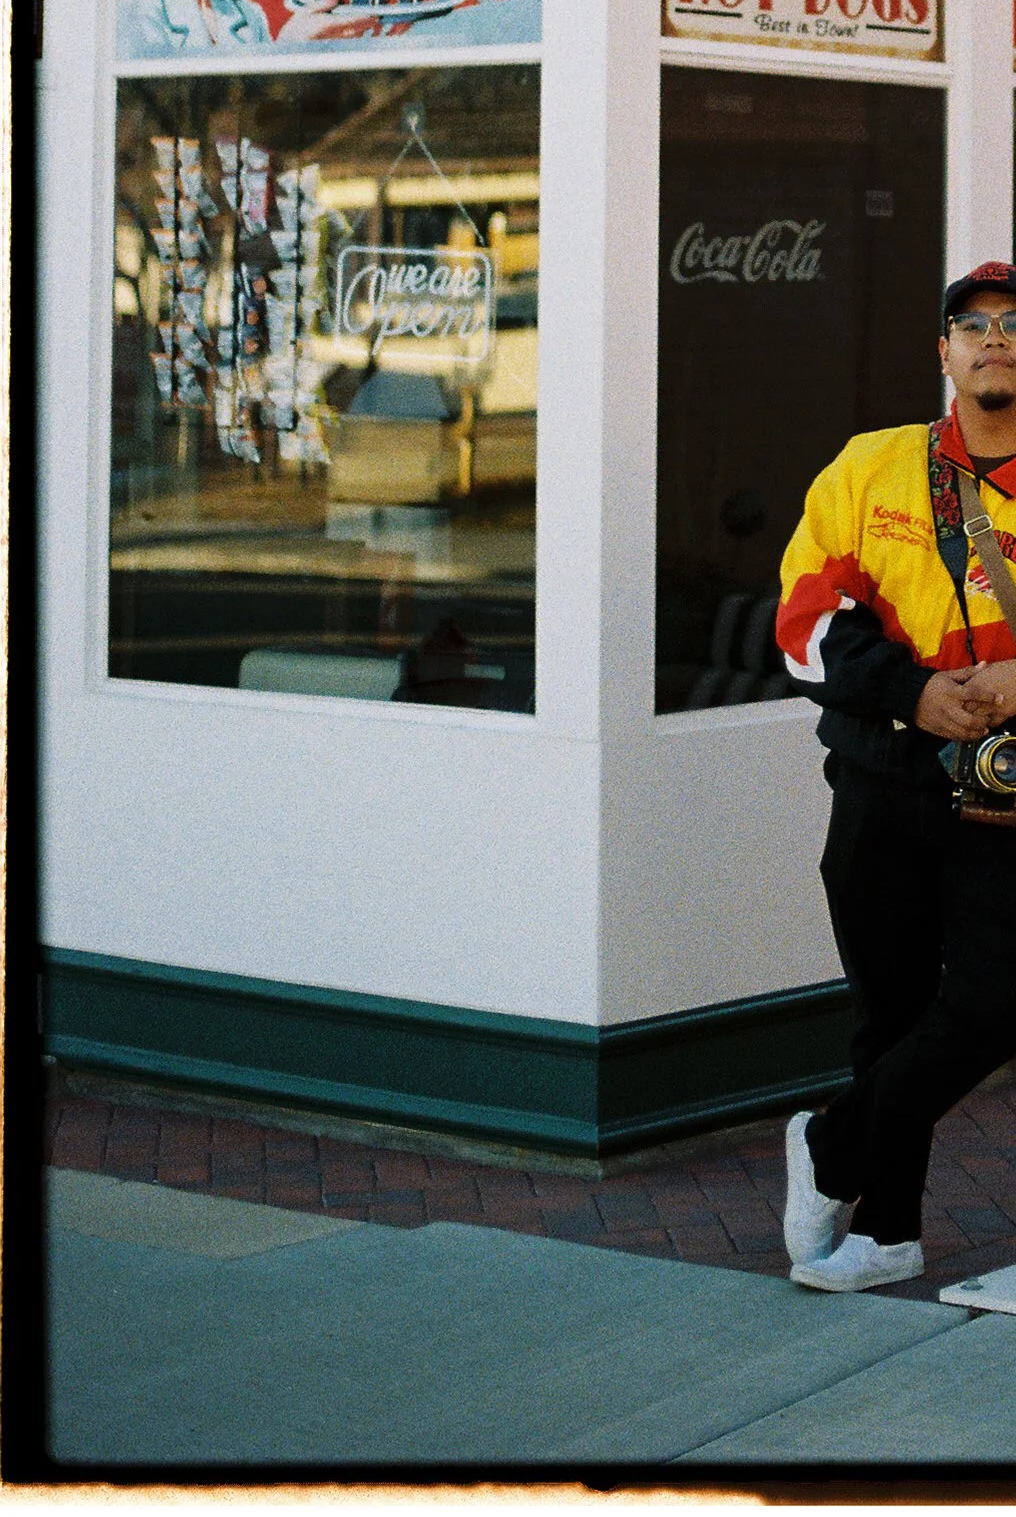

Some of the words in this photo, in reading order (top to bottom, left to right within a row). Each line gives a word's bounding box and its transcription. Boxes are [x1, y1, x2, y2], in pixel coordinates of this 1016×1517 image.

[754, 13, 791, 33] Best
[796, 20, 810, 34] in
[814, 18, 860, 38] Town!
[669, 218, 828, 285] Coca-Cola
[872, 504, 912, 525] Kodak
